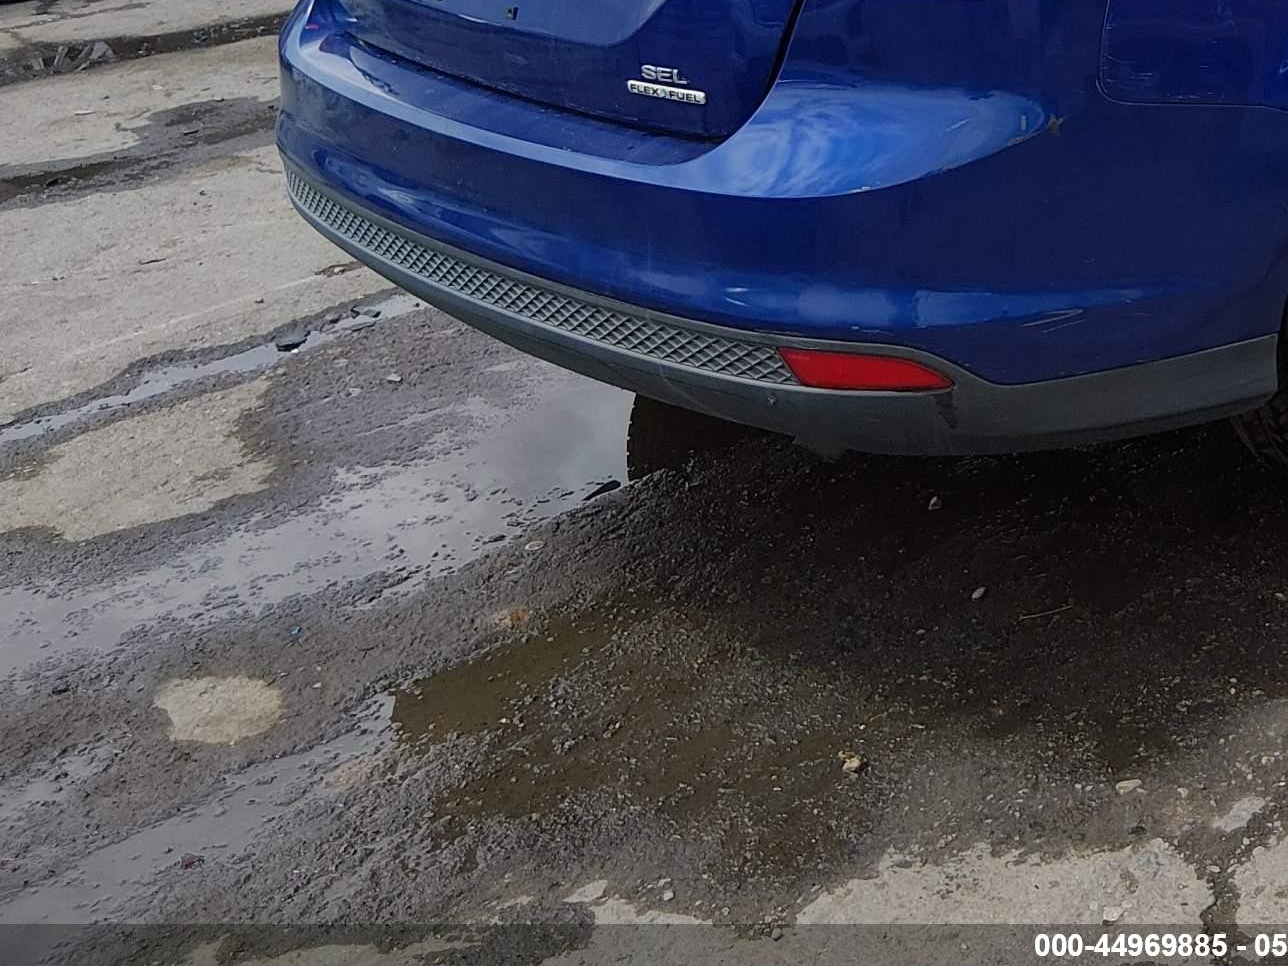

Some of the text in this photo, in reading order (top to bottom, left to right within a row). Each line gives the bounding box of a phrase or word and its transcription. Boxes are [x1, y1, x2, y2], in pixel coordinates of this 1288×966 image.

[641, 64, 689, 84] SEL
[630, 83, 702, 103] FLEX FUEL
